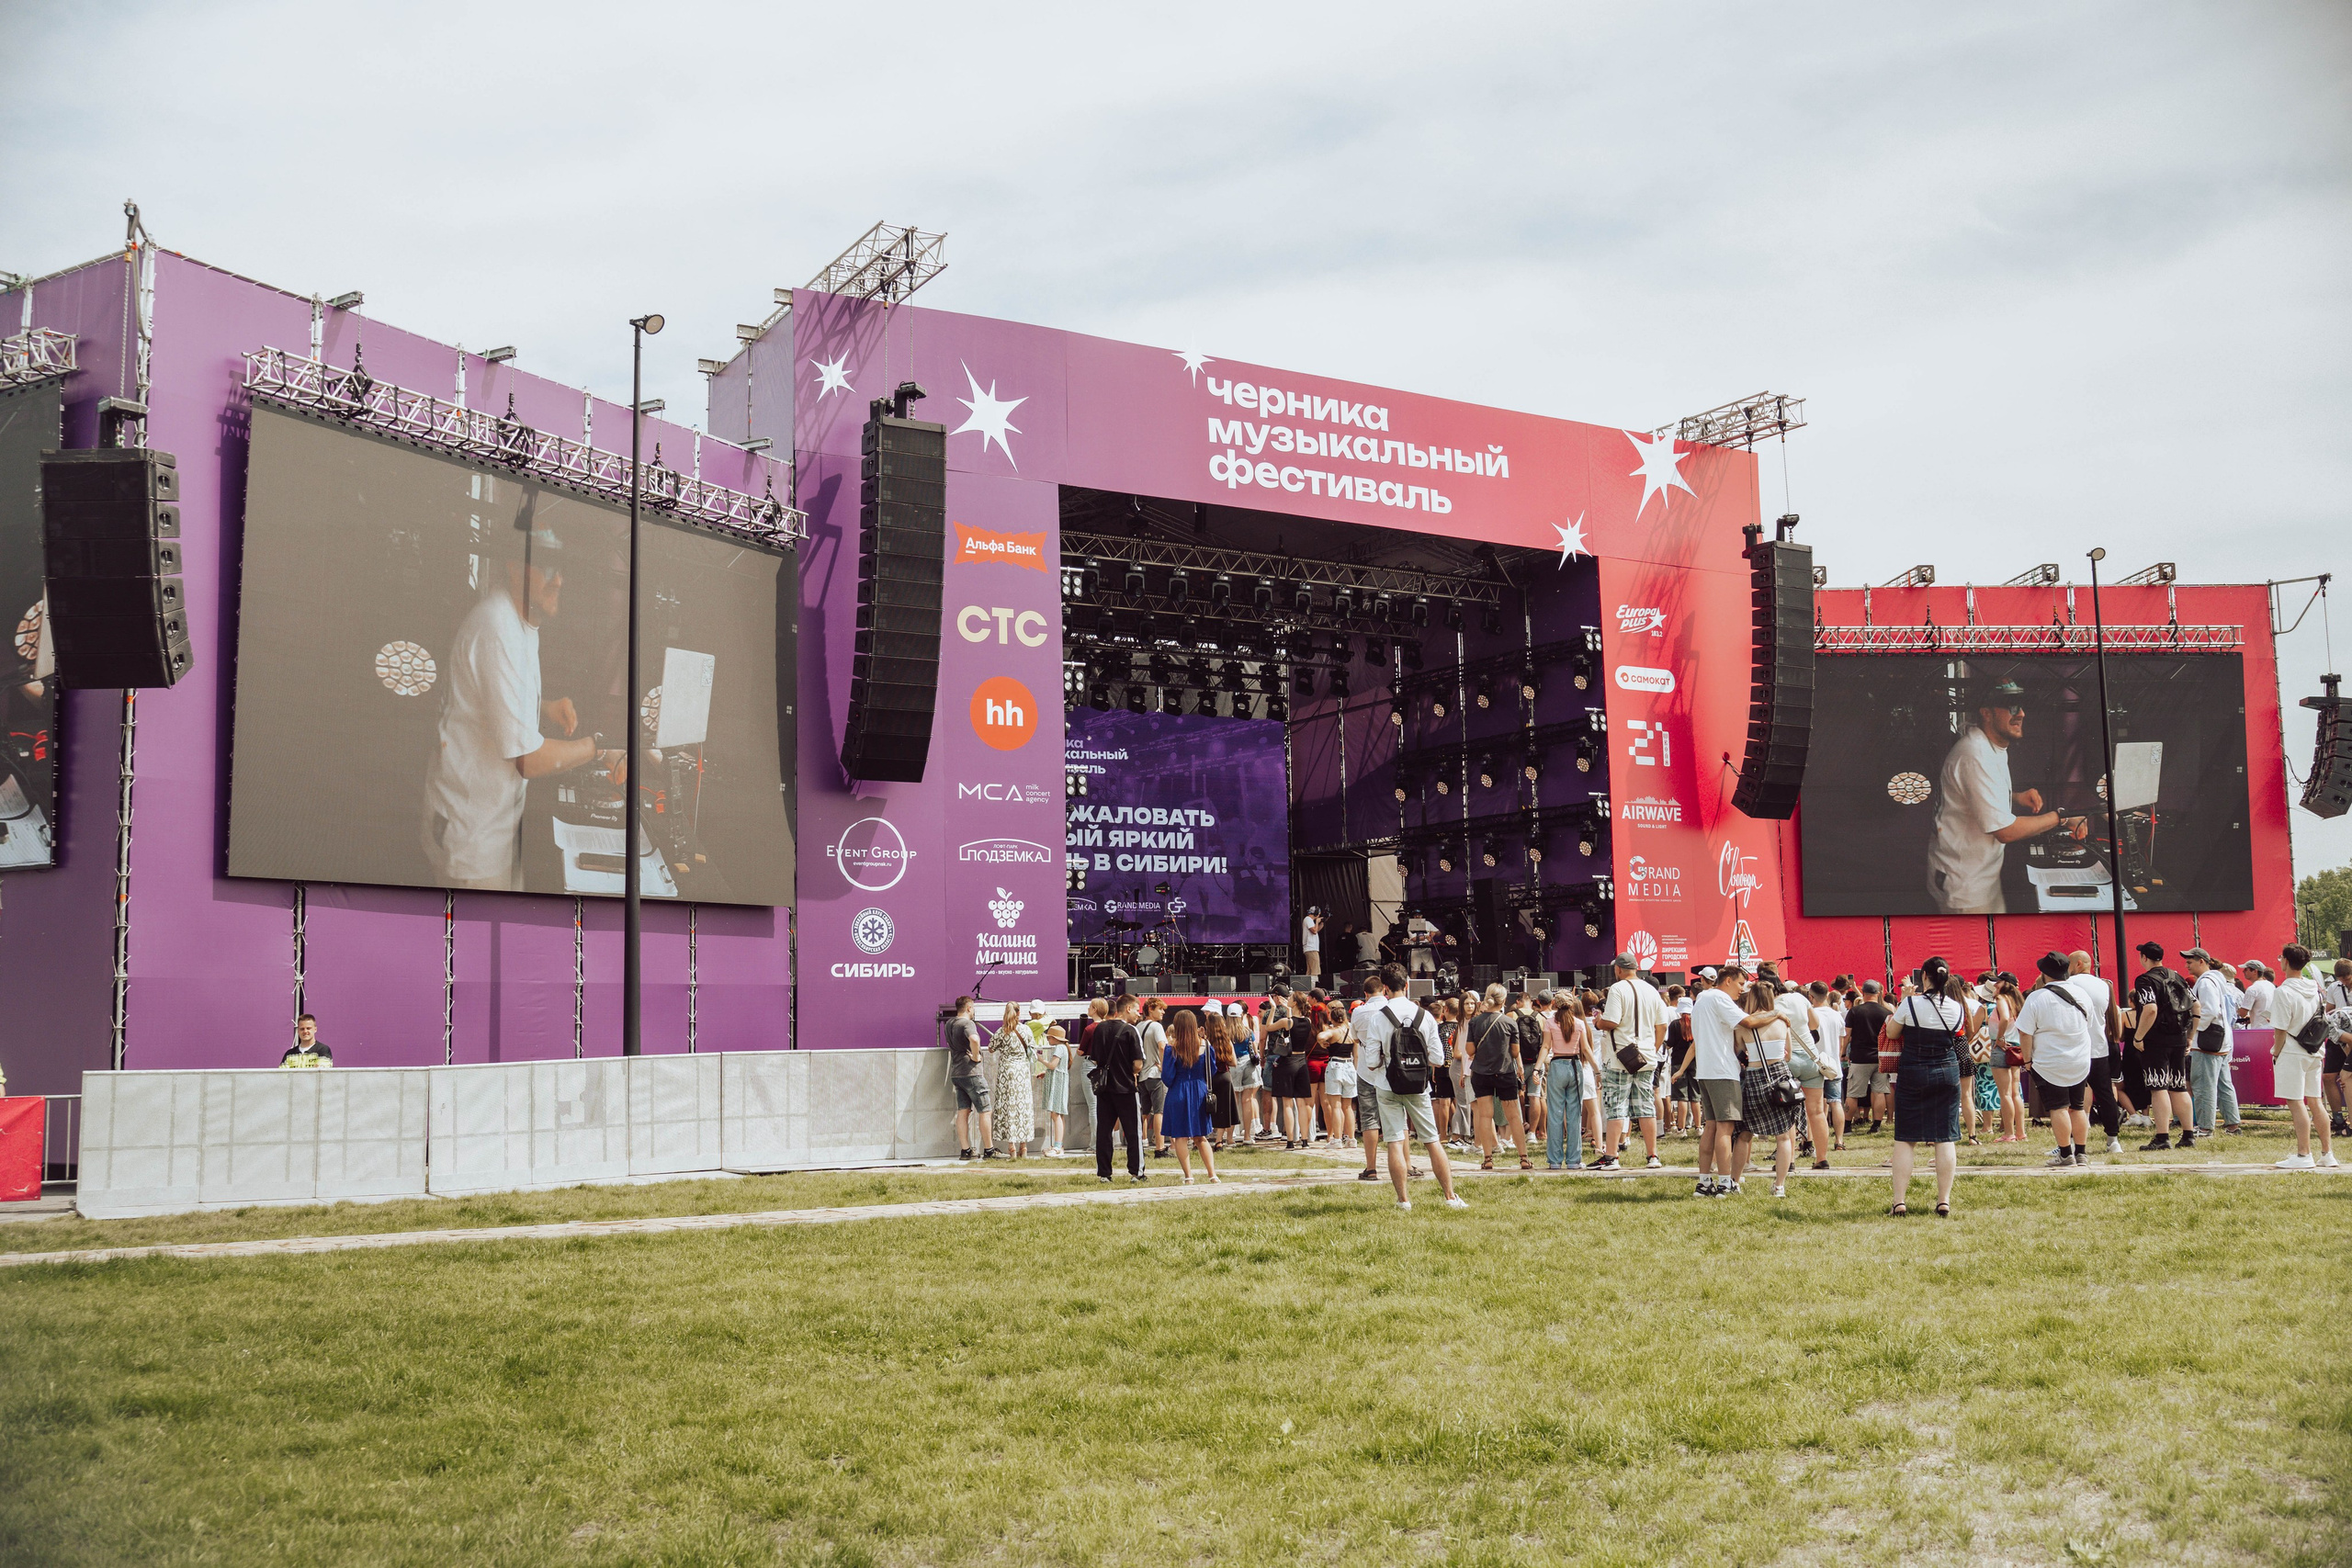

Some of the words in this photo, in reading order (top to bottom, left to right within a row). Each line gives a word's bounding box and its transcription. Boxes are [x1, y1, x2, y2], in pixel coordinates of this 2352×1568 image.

[1206, 376, 1390, 432] черника
[1207, 417, 1510, 479] музыкальный
[1208, 448, 1453, 514] фестиваль
[966, 536, 1005, 553] Альфа
[1007, 541, 1036, 556] Банк
[956, 605, 1048, 648] СТС
[1631, 673, 1670, 686] самокат
[986, 698, 1023, 727] hh
[958, 783, 1023, 801] MCA
[1067, 805, 1216, 827] ЖАЛОВАТЬ
[1622, 805, 1682, 822] AIRWAVE
[1108, 827, 1194, 850] ЯРКИЙ
[967, 849, 1045, 863] ПОДЗЕМКА
[1093, 852, 1111, 871] В
[1116, 854, 1228, 874] СИБИРИ!
[1628, 883, 1681, 897] MEDIA
[976, 932, 1037, 948] Калина
[975, 950, 1038, 965] Малина
[831, 963, 915, 978] СИБИРЬ
[1400, 1057, 1420, 1066] FILA
